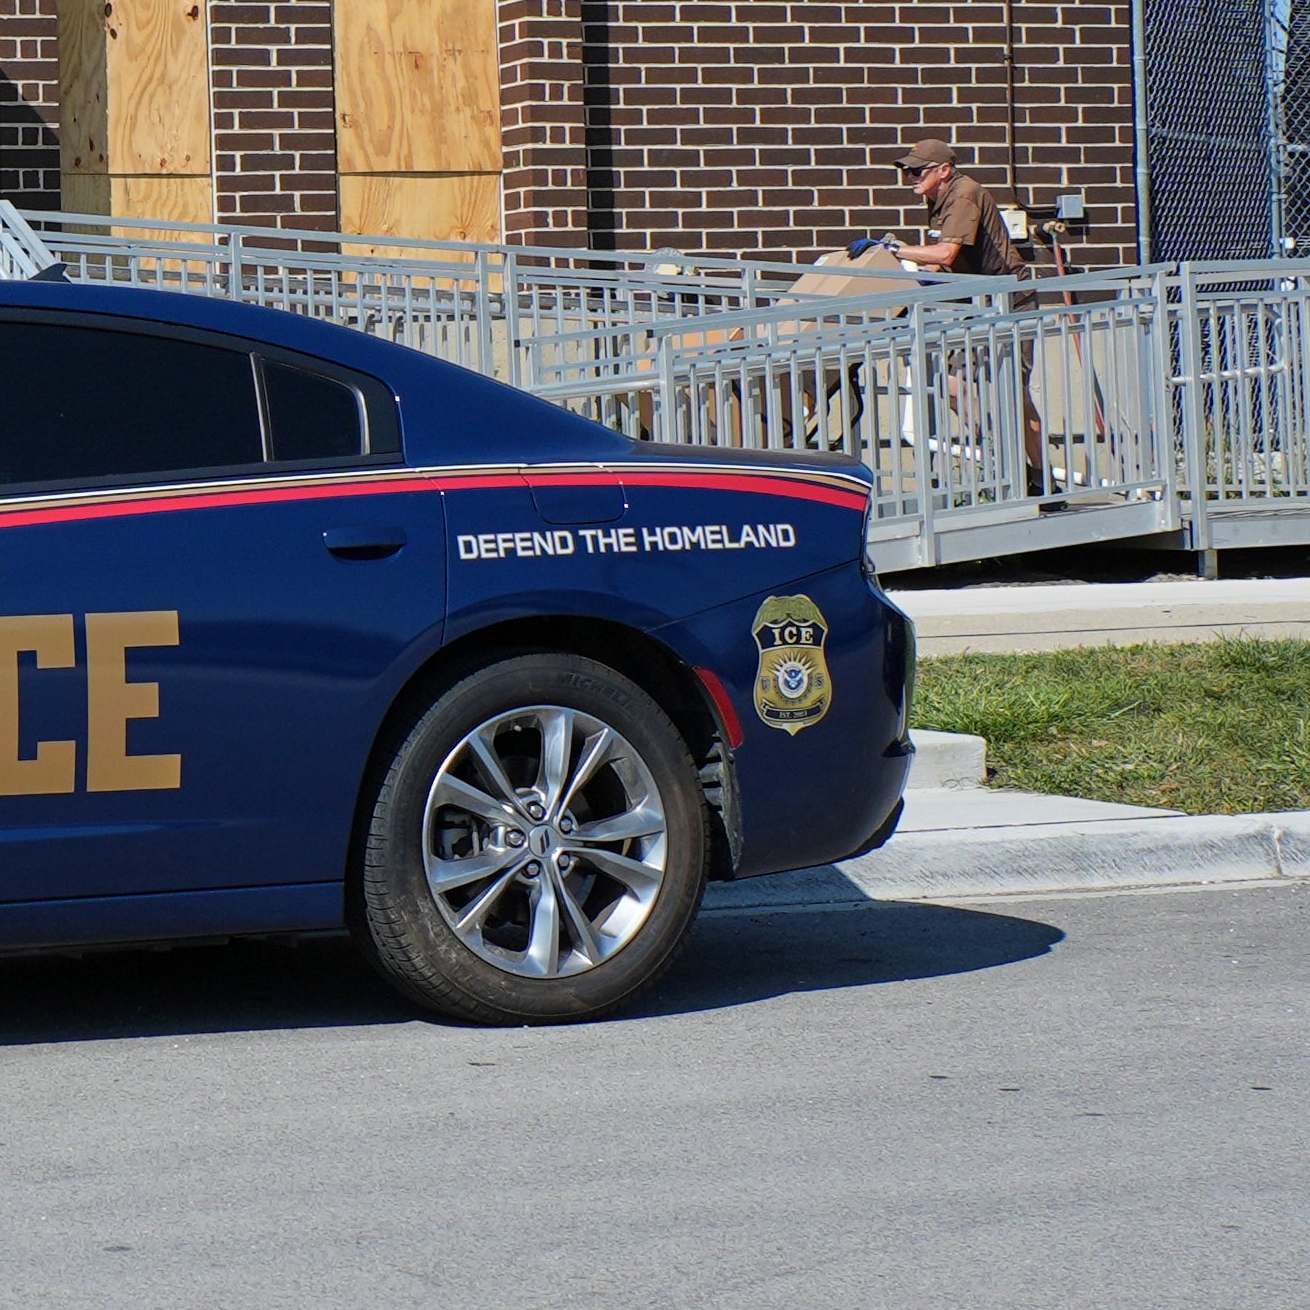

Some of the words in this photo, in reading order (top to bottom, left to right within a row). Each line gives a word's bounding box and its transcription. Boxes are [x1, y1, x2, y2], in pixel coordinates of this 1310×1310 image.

[457, 530, 575, 560] DEFEND
[578, 528, 638, 554] THE
[642, 523, 797, 552] HOMELAND
[771, 626, 814, 646] ICE
